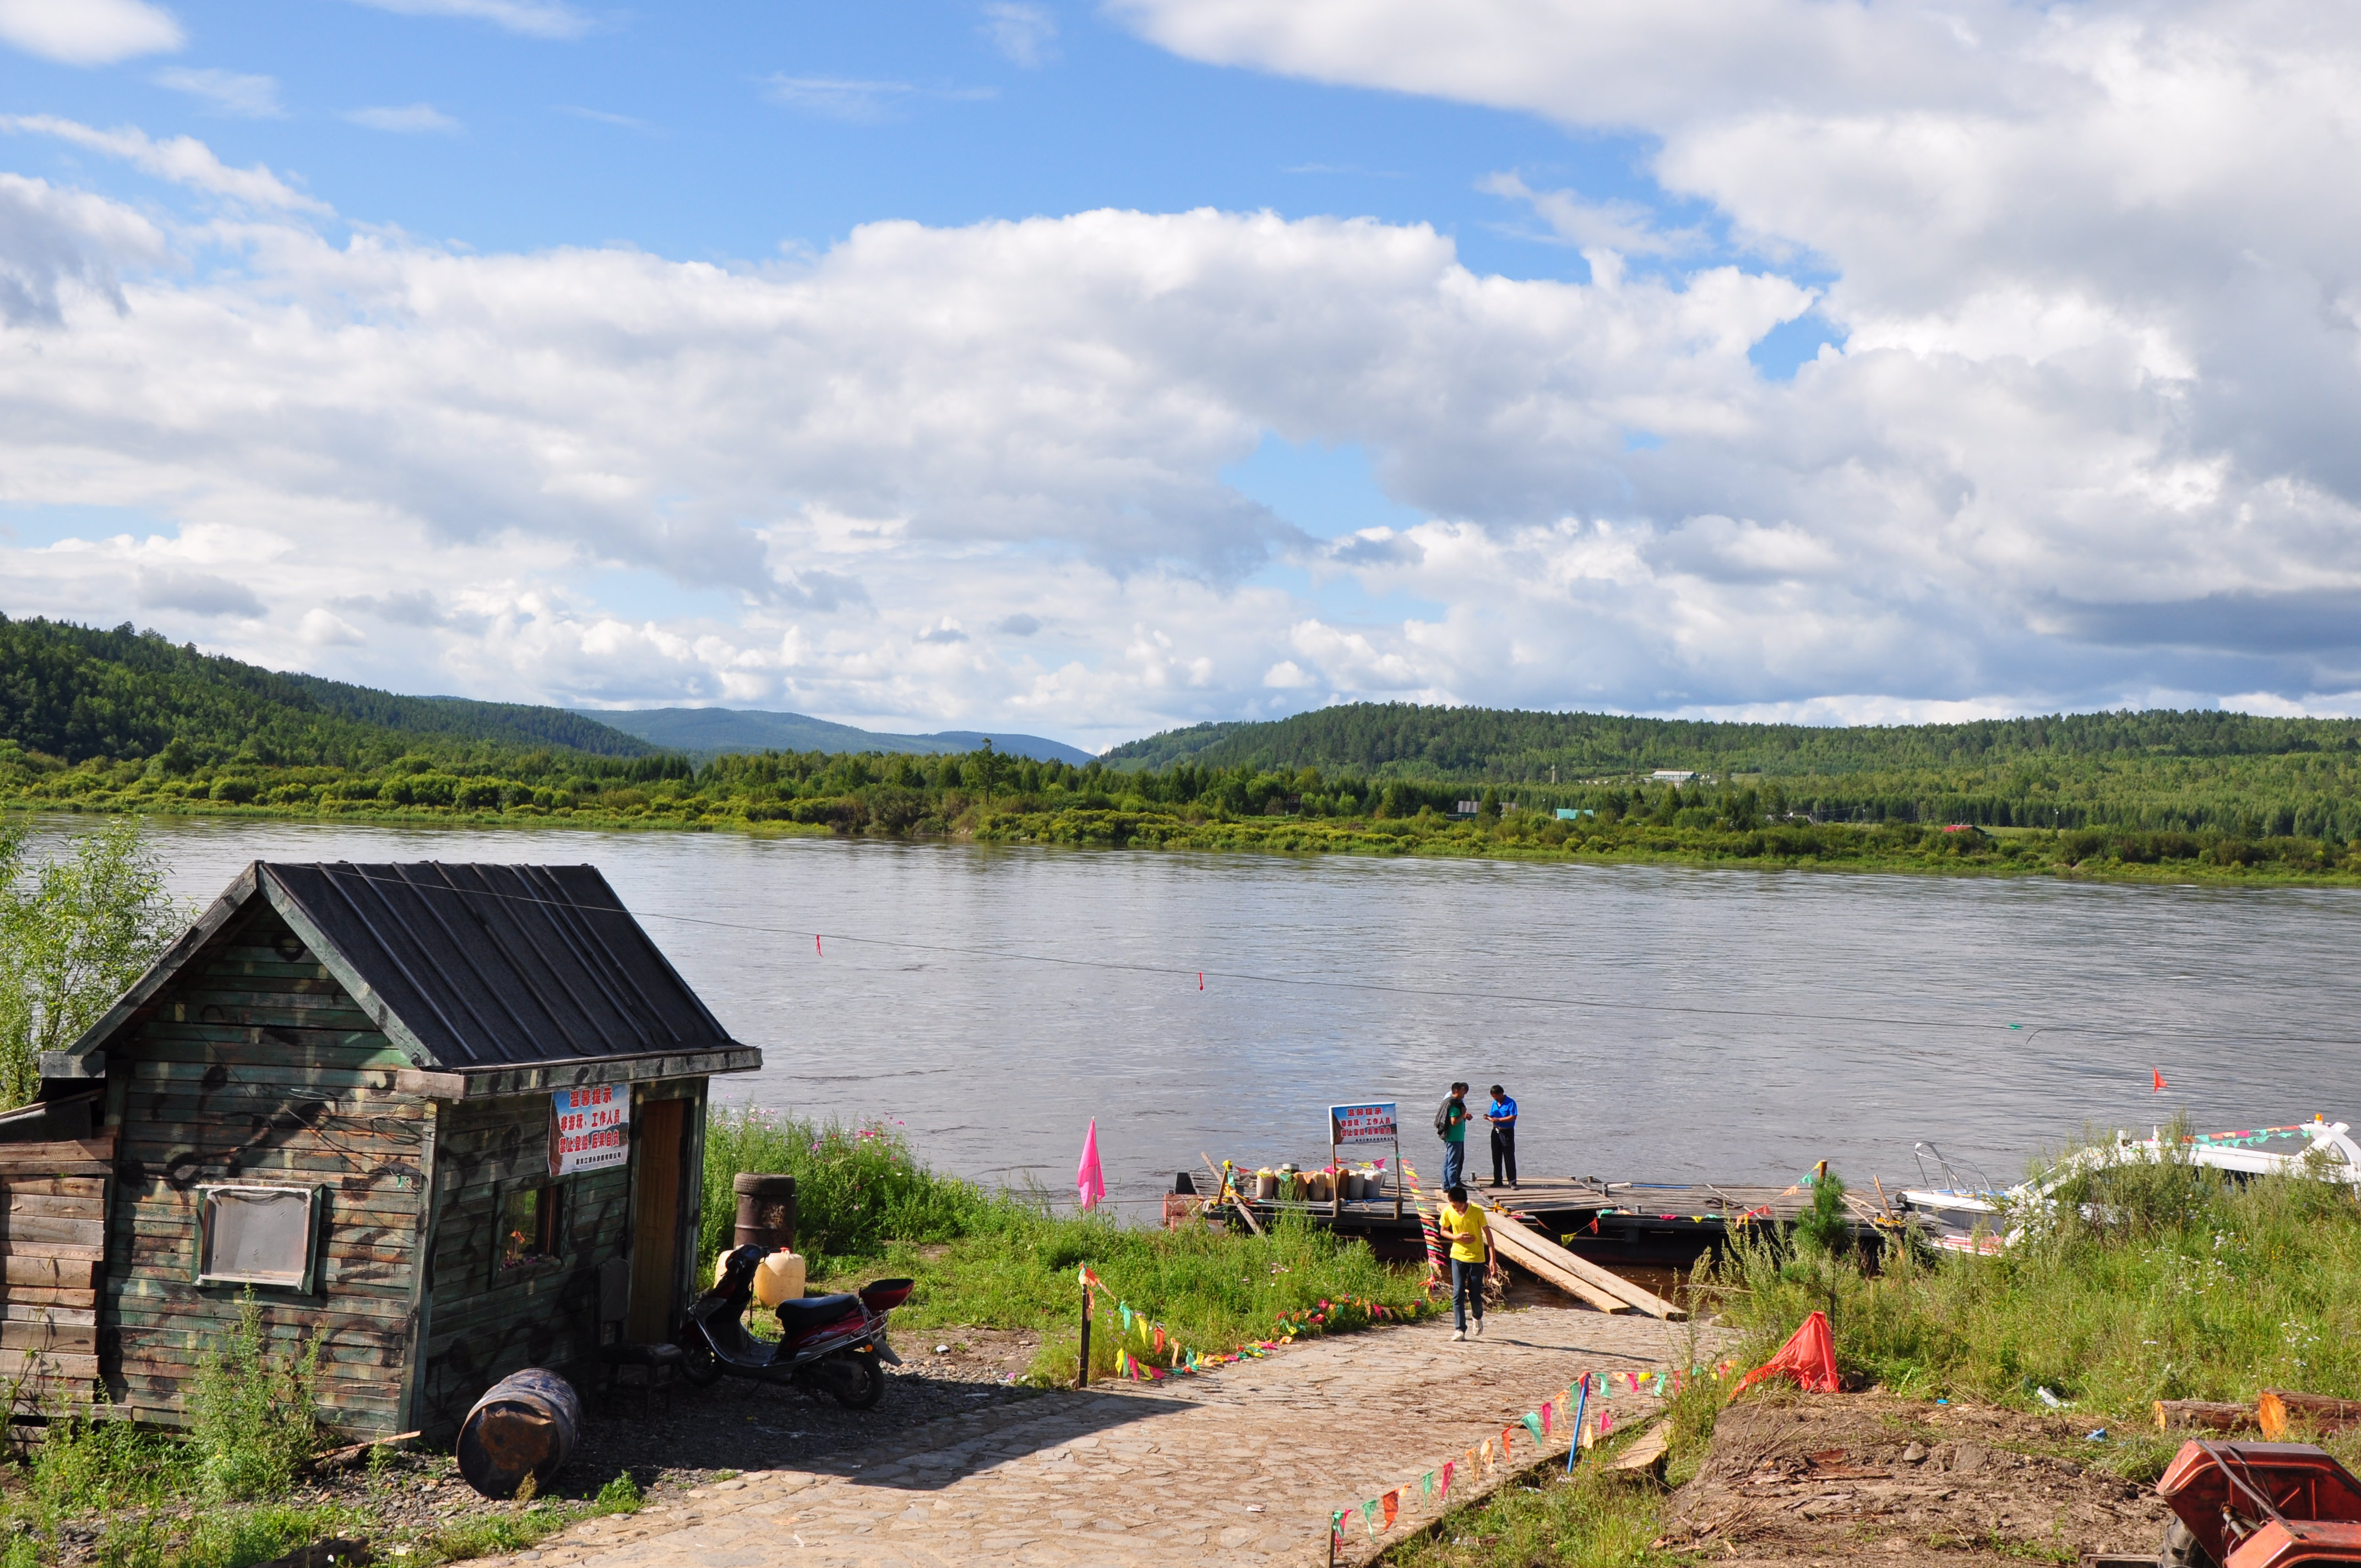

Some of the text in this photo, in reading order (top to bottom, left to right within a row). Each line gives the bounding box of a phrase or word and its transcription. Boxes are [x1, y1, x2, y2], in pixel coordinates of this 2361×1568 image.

[569, 1087, 612, 1108] 温馨提示
[561, 1109, 620, 1131] 非游玩、工作人员
[1347, 1107, 1382, 1117] 温馨提示
[559, 1130, 619, 1154] 禁止登船 后果自负
